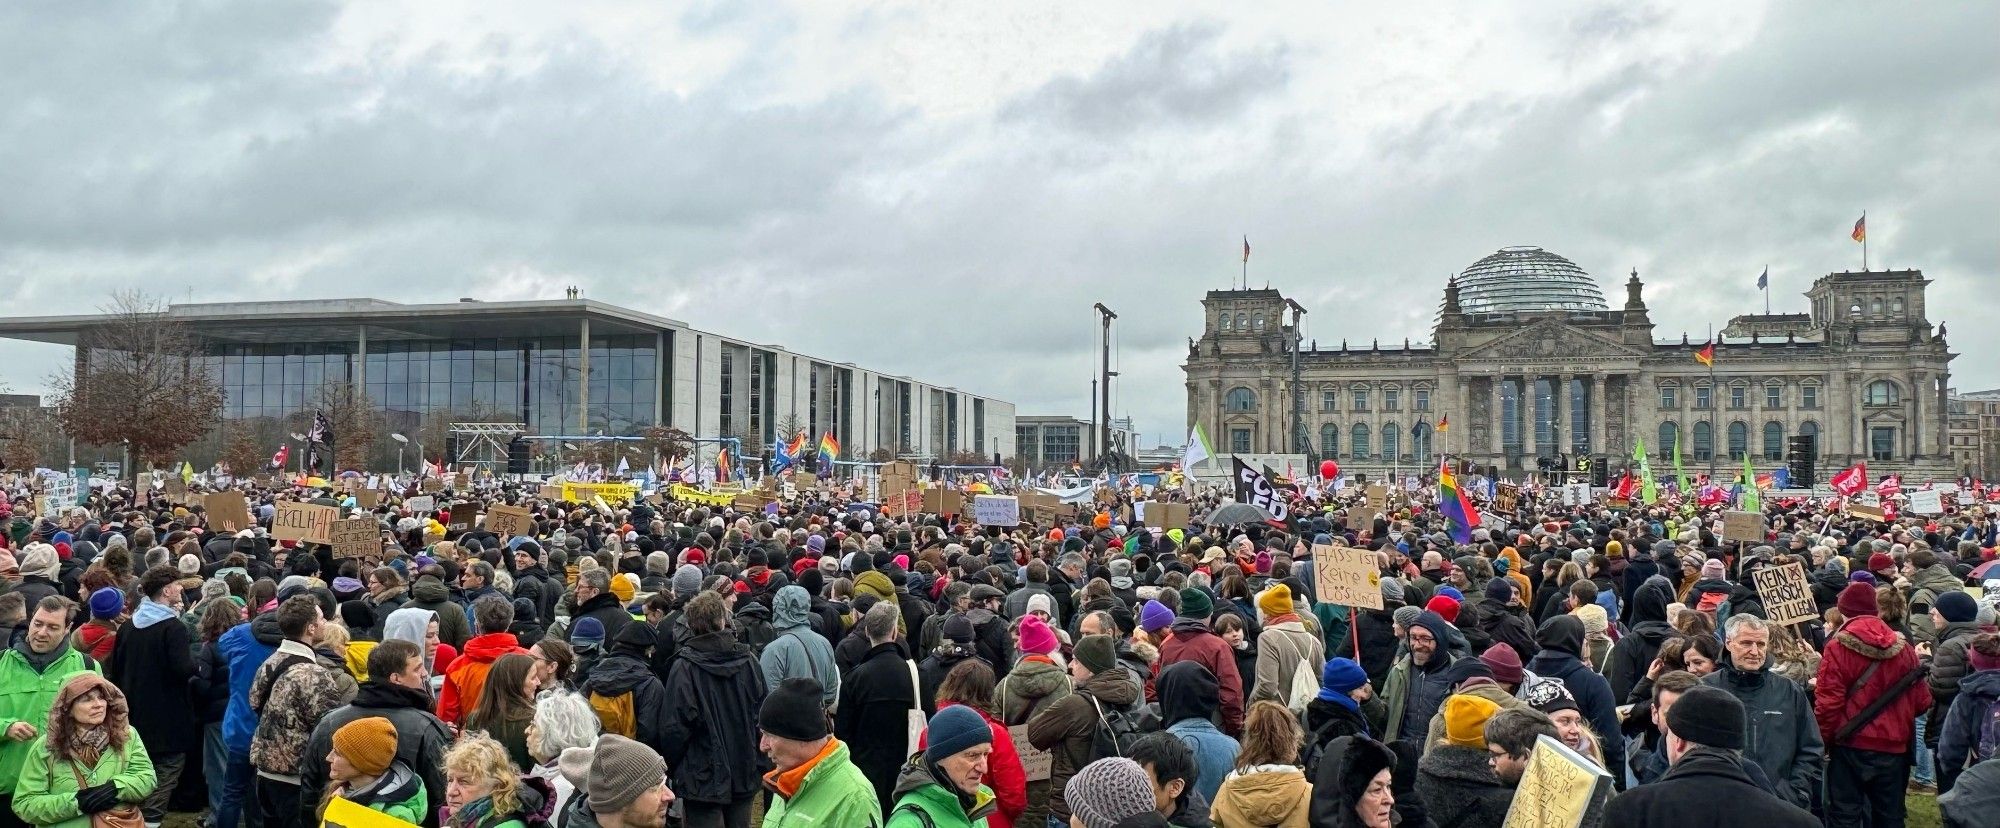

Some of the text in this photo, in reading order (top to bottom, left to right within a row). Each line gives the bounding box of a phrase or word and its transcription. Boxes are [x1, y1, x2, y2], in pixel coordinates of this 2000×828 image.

[1315, 546, 1376, 567] HASS IST
[1319, 563, 1360, 586] Keine
[1755, 567, 1788, 591] KEIN
[1762, 581, 1805, 607] MENSCH
[1767, 605, 1783, 621] IST
